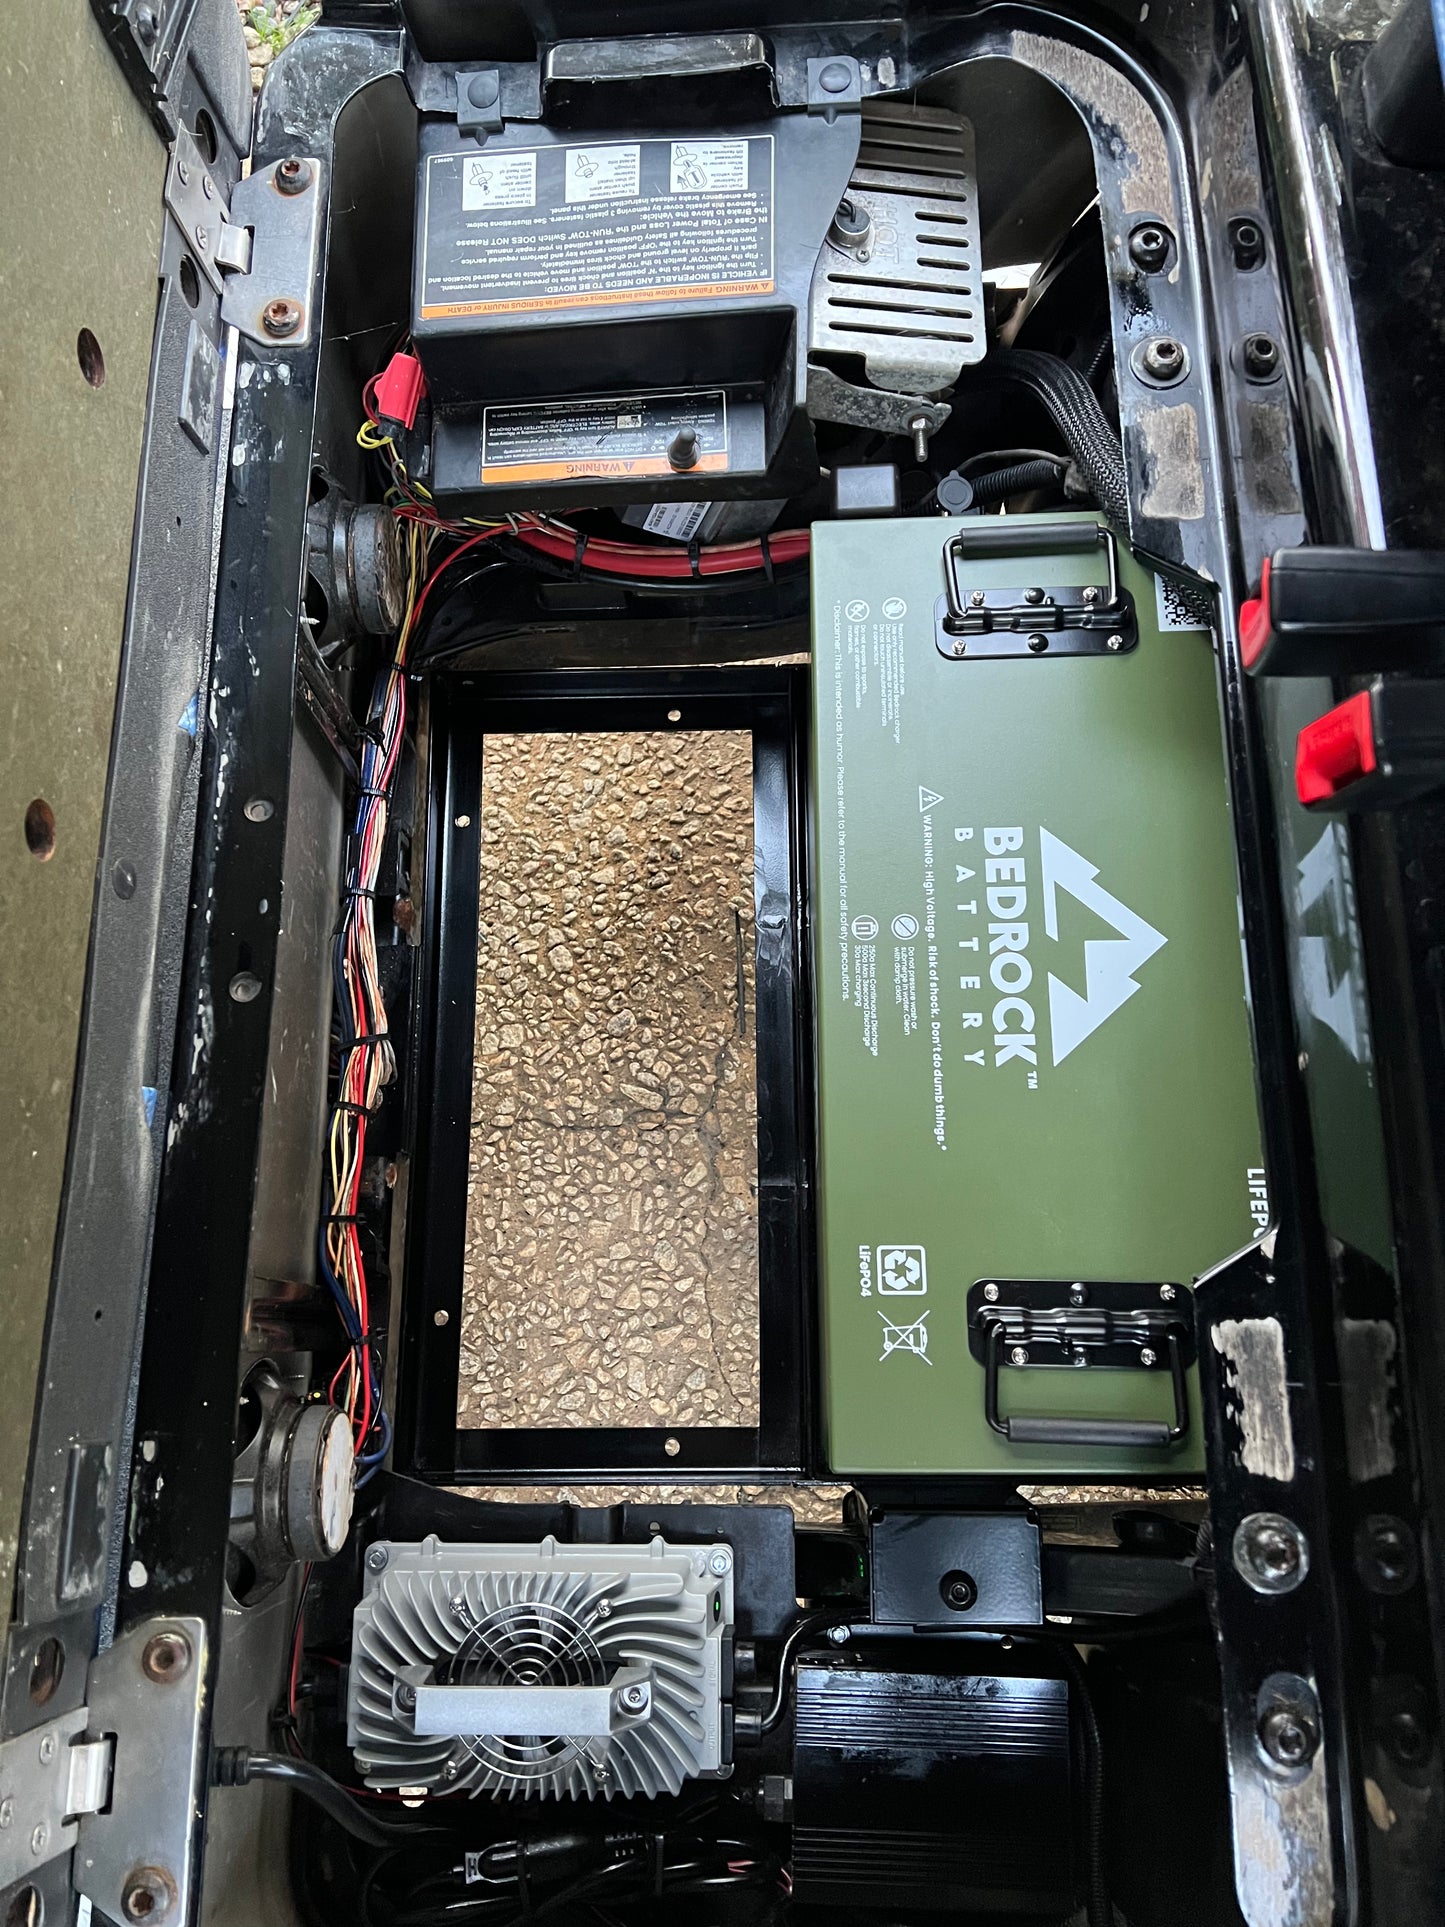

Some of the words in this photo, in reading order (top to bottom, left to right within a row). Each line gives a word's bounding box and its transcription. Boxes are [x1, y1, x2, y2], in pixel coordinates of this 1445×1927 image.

[490, 237, 509, 245] NOT
[511, 235, 536, 244] DOES
[605, 278, 633, 288] NEEDS
[635, 276, 653, 284] AND
[655, 272, 709, 283] INOPERABLE
[721, 269, 757, 278] VEHICLE
[544, 284, 576, 293] MOVED:
[566, 462, 619, 473] WARNING
[835, 720, 842, 732] as
[837, 797, 845, 818] refer
[838, 819, 845, 829] to
[838, 830, 846, 845] the
[923, 814, 933, 867] WARNING:
[838, 847, 847, 883] manual
[839, 885, 847, 897] for
[923, 871, 935, 895] High
[839, 898, 848, 910] all
[839, 912, 849, 940] safety
[925, 896, 935, 941] Voltage.
[860, 944, 868, 962] 500a
[928, 945, 938, 968] Risk
[954, 827, 986, 1066] BATTERY
[900, 946, 908, 982] submerge
[984, 826, 1037, 1067] BEDROCK
[1027, 1071, 1038, 1089] TM
[839, 942, 850, 1000] precautions.
[893, 962, 902, 984] damp
[928, 969, 939, 980] of
[854, 974, 862, 1006] charging
[907, 970, 915, 1000] pressure
[929, 982, 940, 1018] shock.
[932, 1053, 942, 1068] do
[933, 1069, 944, 1103] dumb
[859, 1245, 872, 1297] LiFePO4
